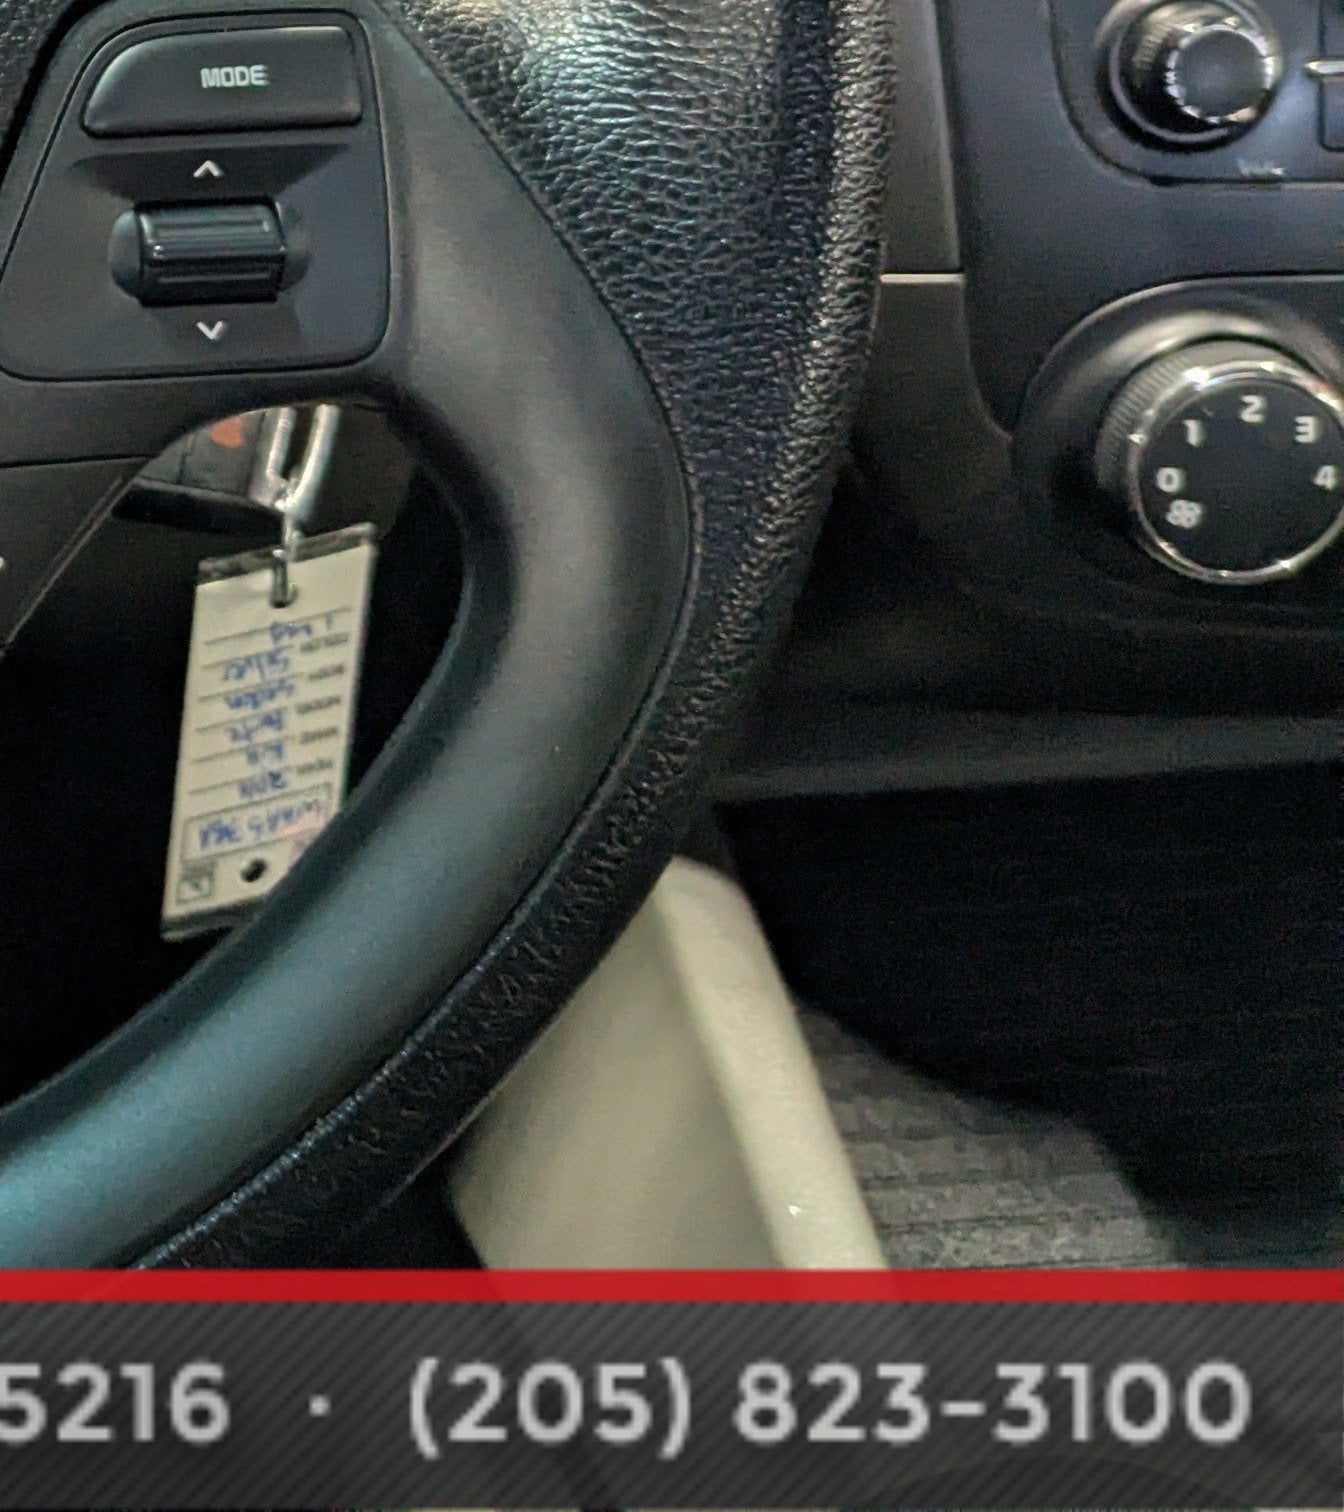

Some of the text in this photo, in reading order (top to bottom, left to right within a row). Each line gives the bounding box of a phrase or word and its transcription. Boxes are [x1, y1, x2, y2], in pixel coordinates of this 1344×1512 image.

[200, 65, 269, 89] MODE
[1239, 394, 1265, 424] 2
[1183, 418, 1205, 448] 1
[1294, 415, 1319, 445] 3
[1155, 466, 1185, 495] 0
[1313, 464, 1339, 492] 4
